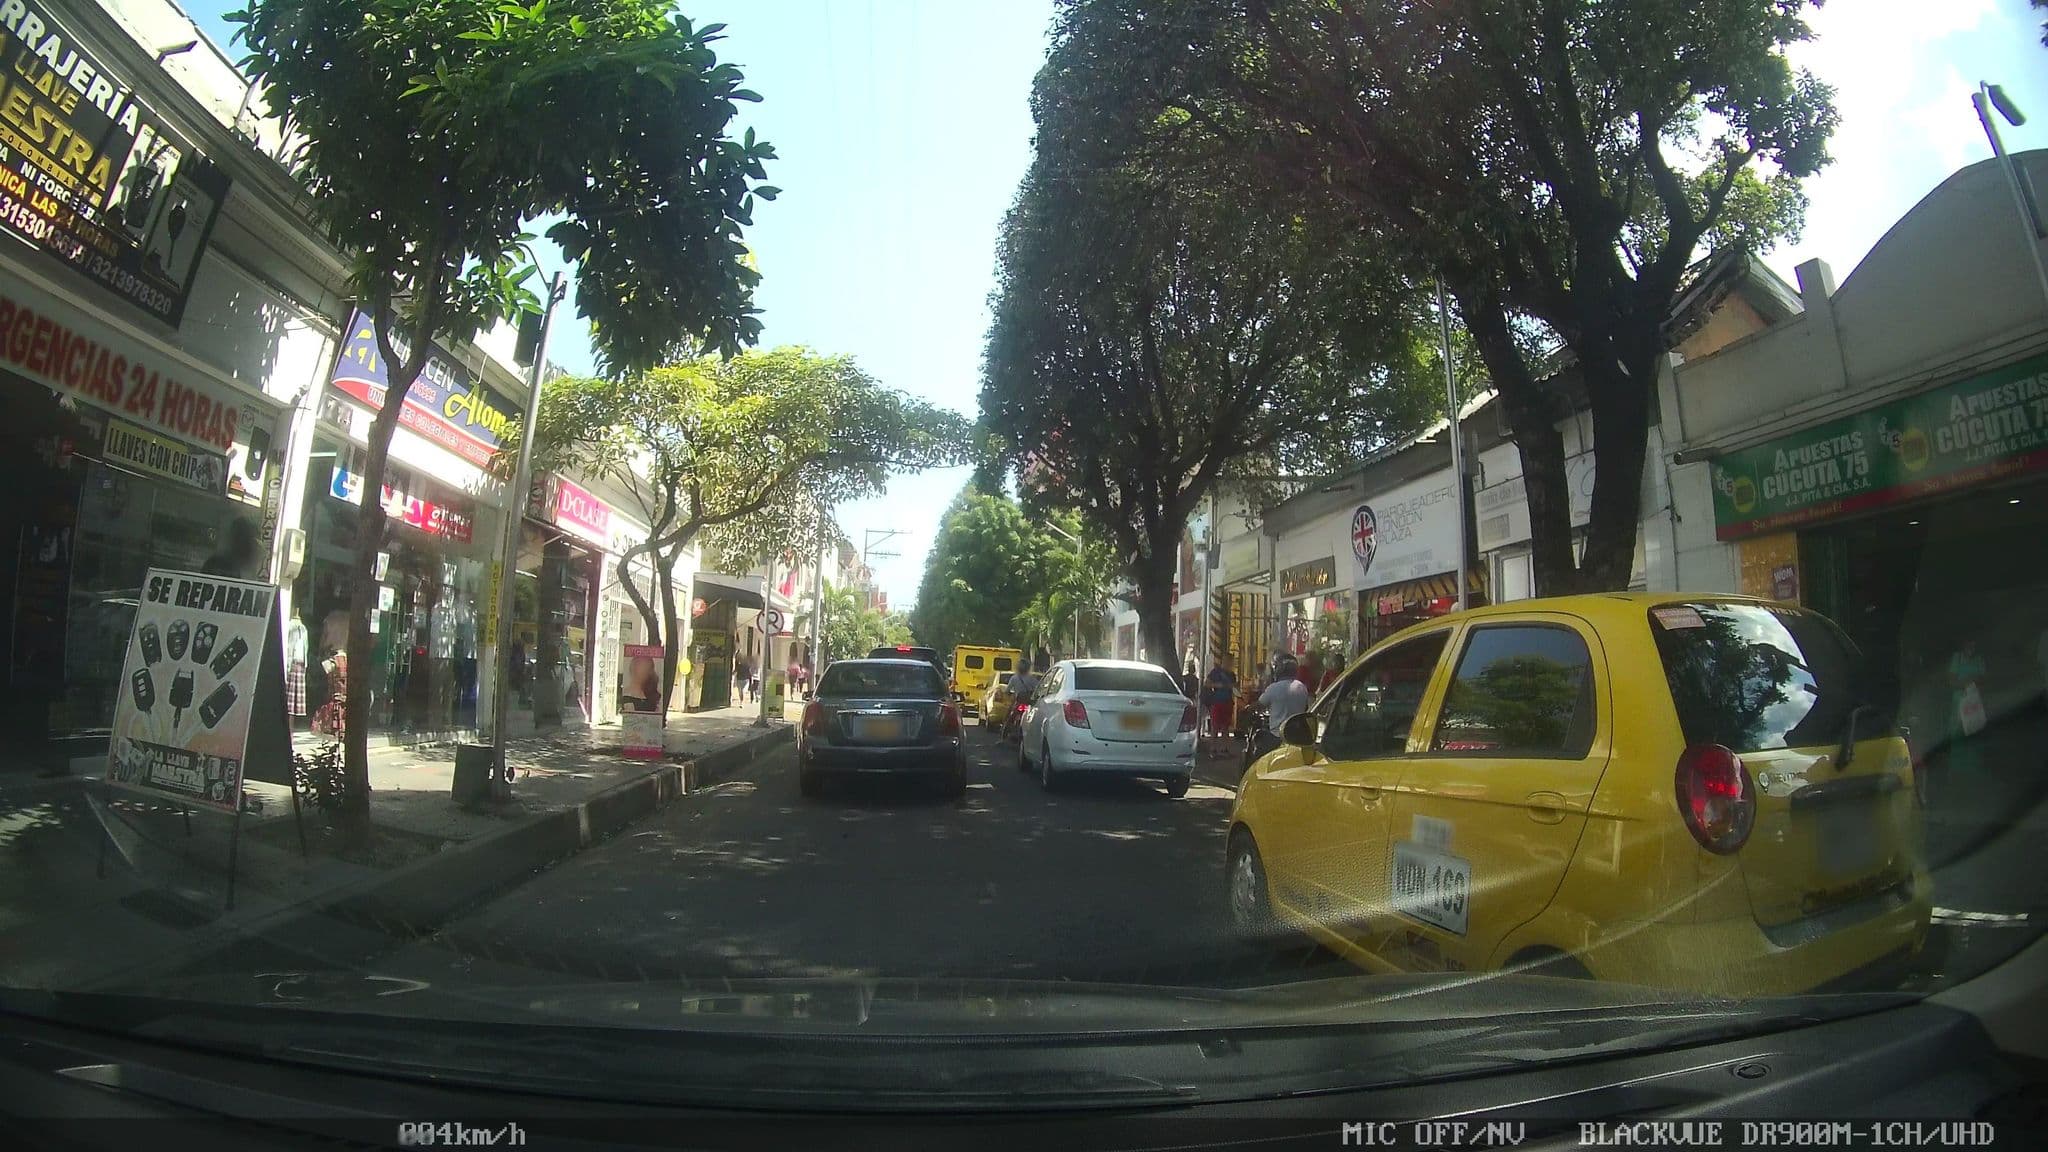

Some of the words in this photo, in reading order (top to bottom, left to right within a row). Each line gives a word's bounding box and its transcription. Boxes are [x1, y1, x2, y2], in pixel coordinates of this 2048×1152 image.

[14, 50, 80, 116] LLAVE
[0, 75, 113, 192] ESTRA
[31, 187, 58, 218] LAS
[127, 363, 158, 421] 24
[158, 381, 238, 450] HORAS
[1936, 404, 2031, 453] CÚCUTA
[106, 427, 147, 465] LLAVES
[149, 444, 171, 473] CON
[1774, 431, 1865, 472] APUESTAS
[1762, 457, 1841, 500] CÚCUTA
[1843, 450, 1870, 479] 75
[1377, 526, 1413, 546] PLAZA
[147, 575, 171, 605] SE
[174, 579, 273, 619] REPARAN
